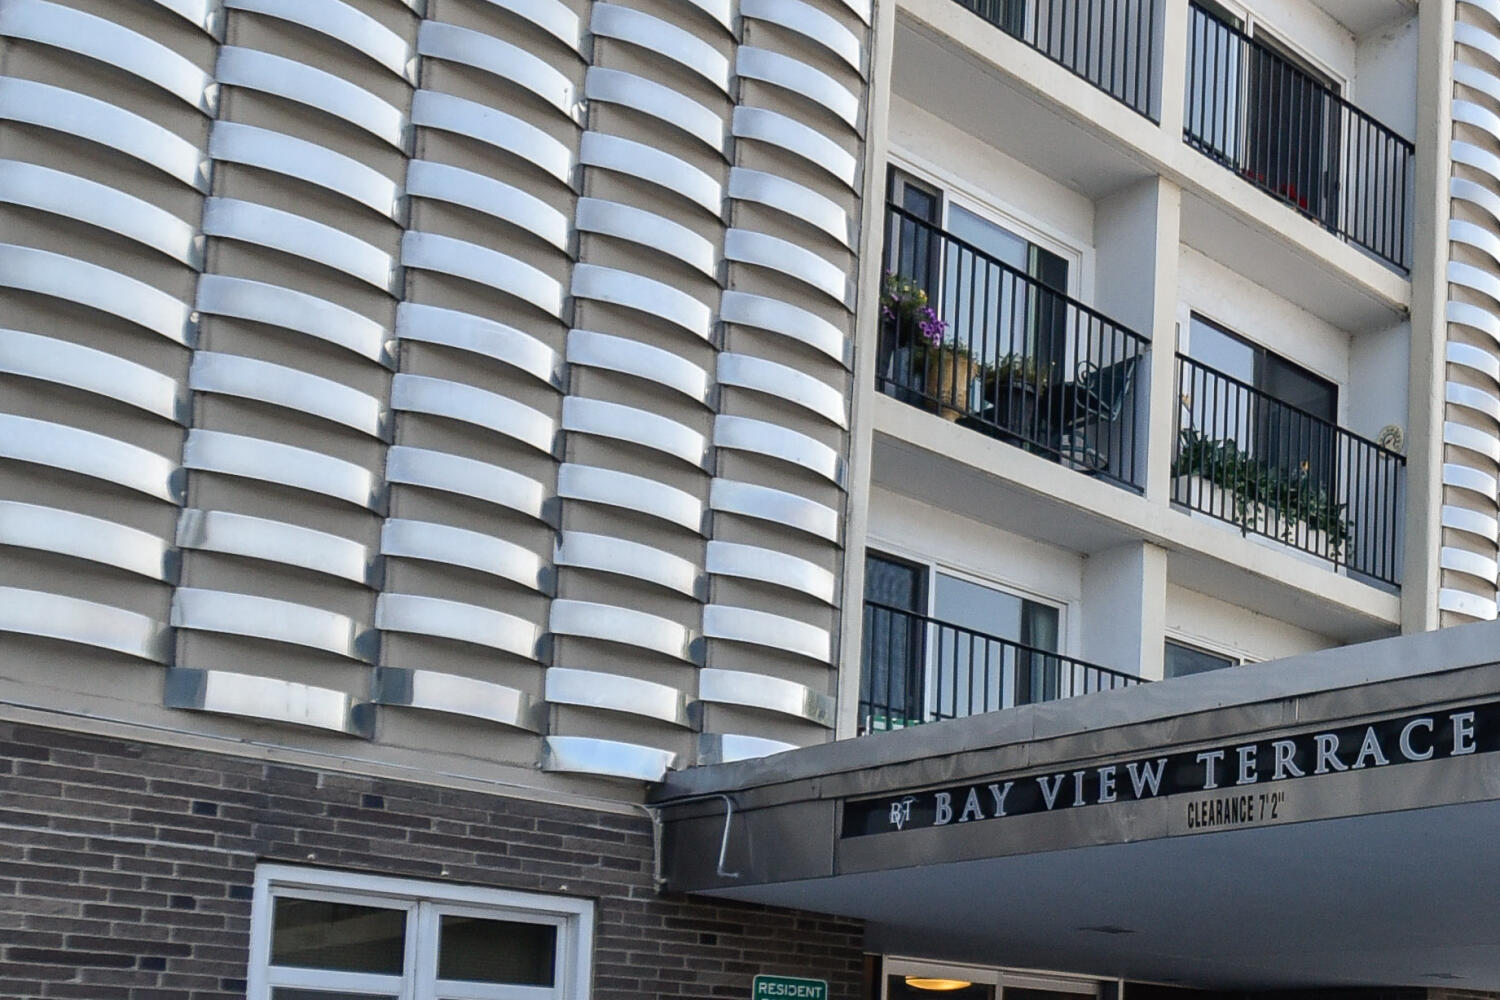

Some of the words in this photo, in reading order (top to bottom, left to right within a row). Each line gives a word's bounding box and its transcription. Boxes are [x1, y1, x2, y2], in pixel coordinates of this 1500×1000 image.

[933, 782, 1014, 825] BAY
[1036, 758, 1167, 810] VIEW
[1196, 711, 1476, 789] TERRACE
[1187, 795, 1254, 829] CLEARANCE
[1259, 791, 1285, 820] 7'2"
[758, 982, 822, 998] RESIDENT
